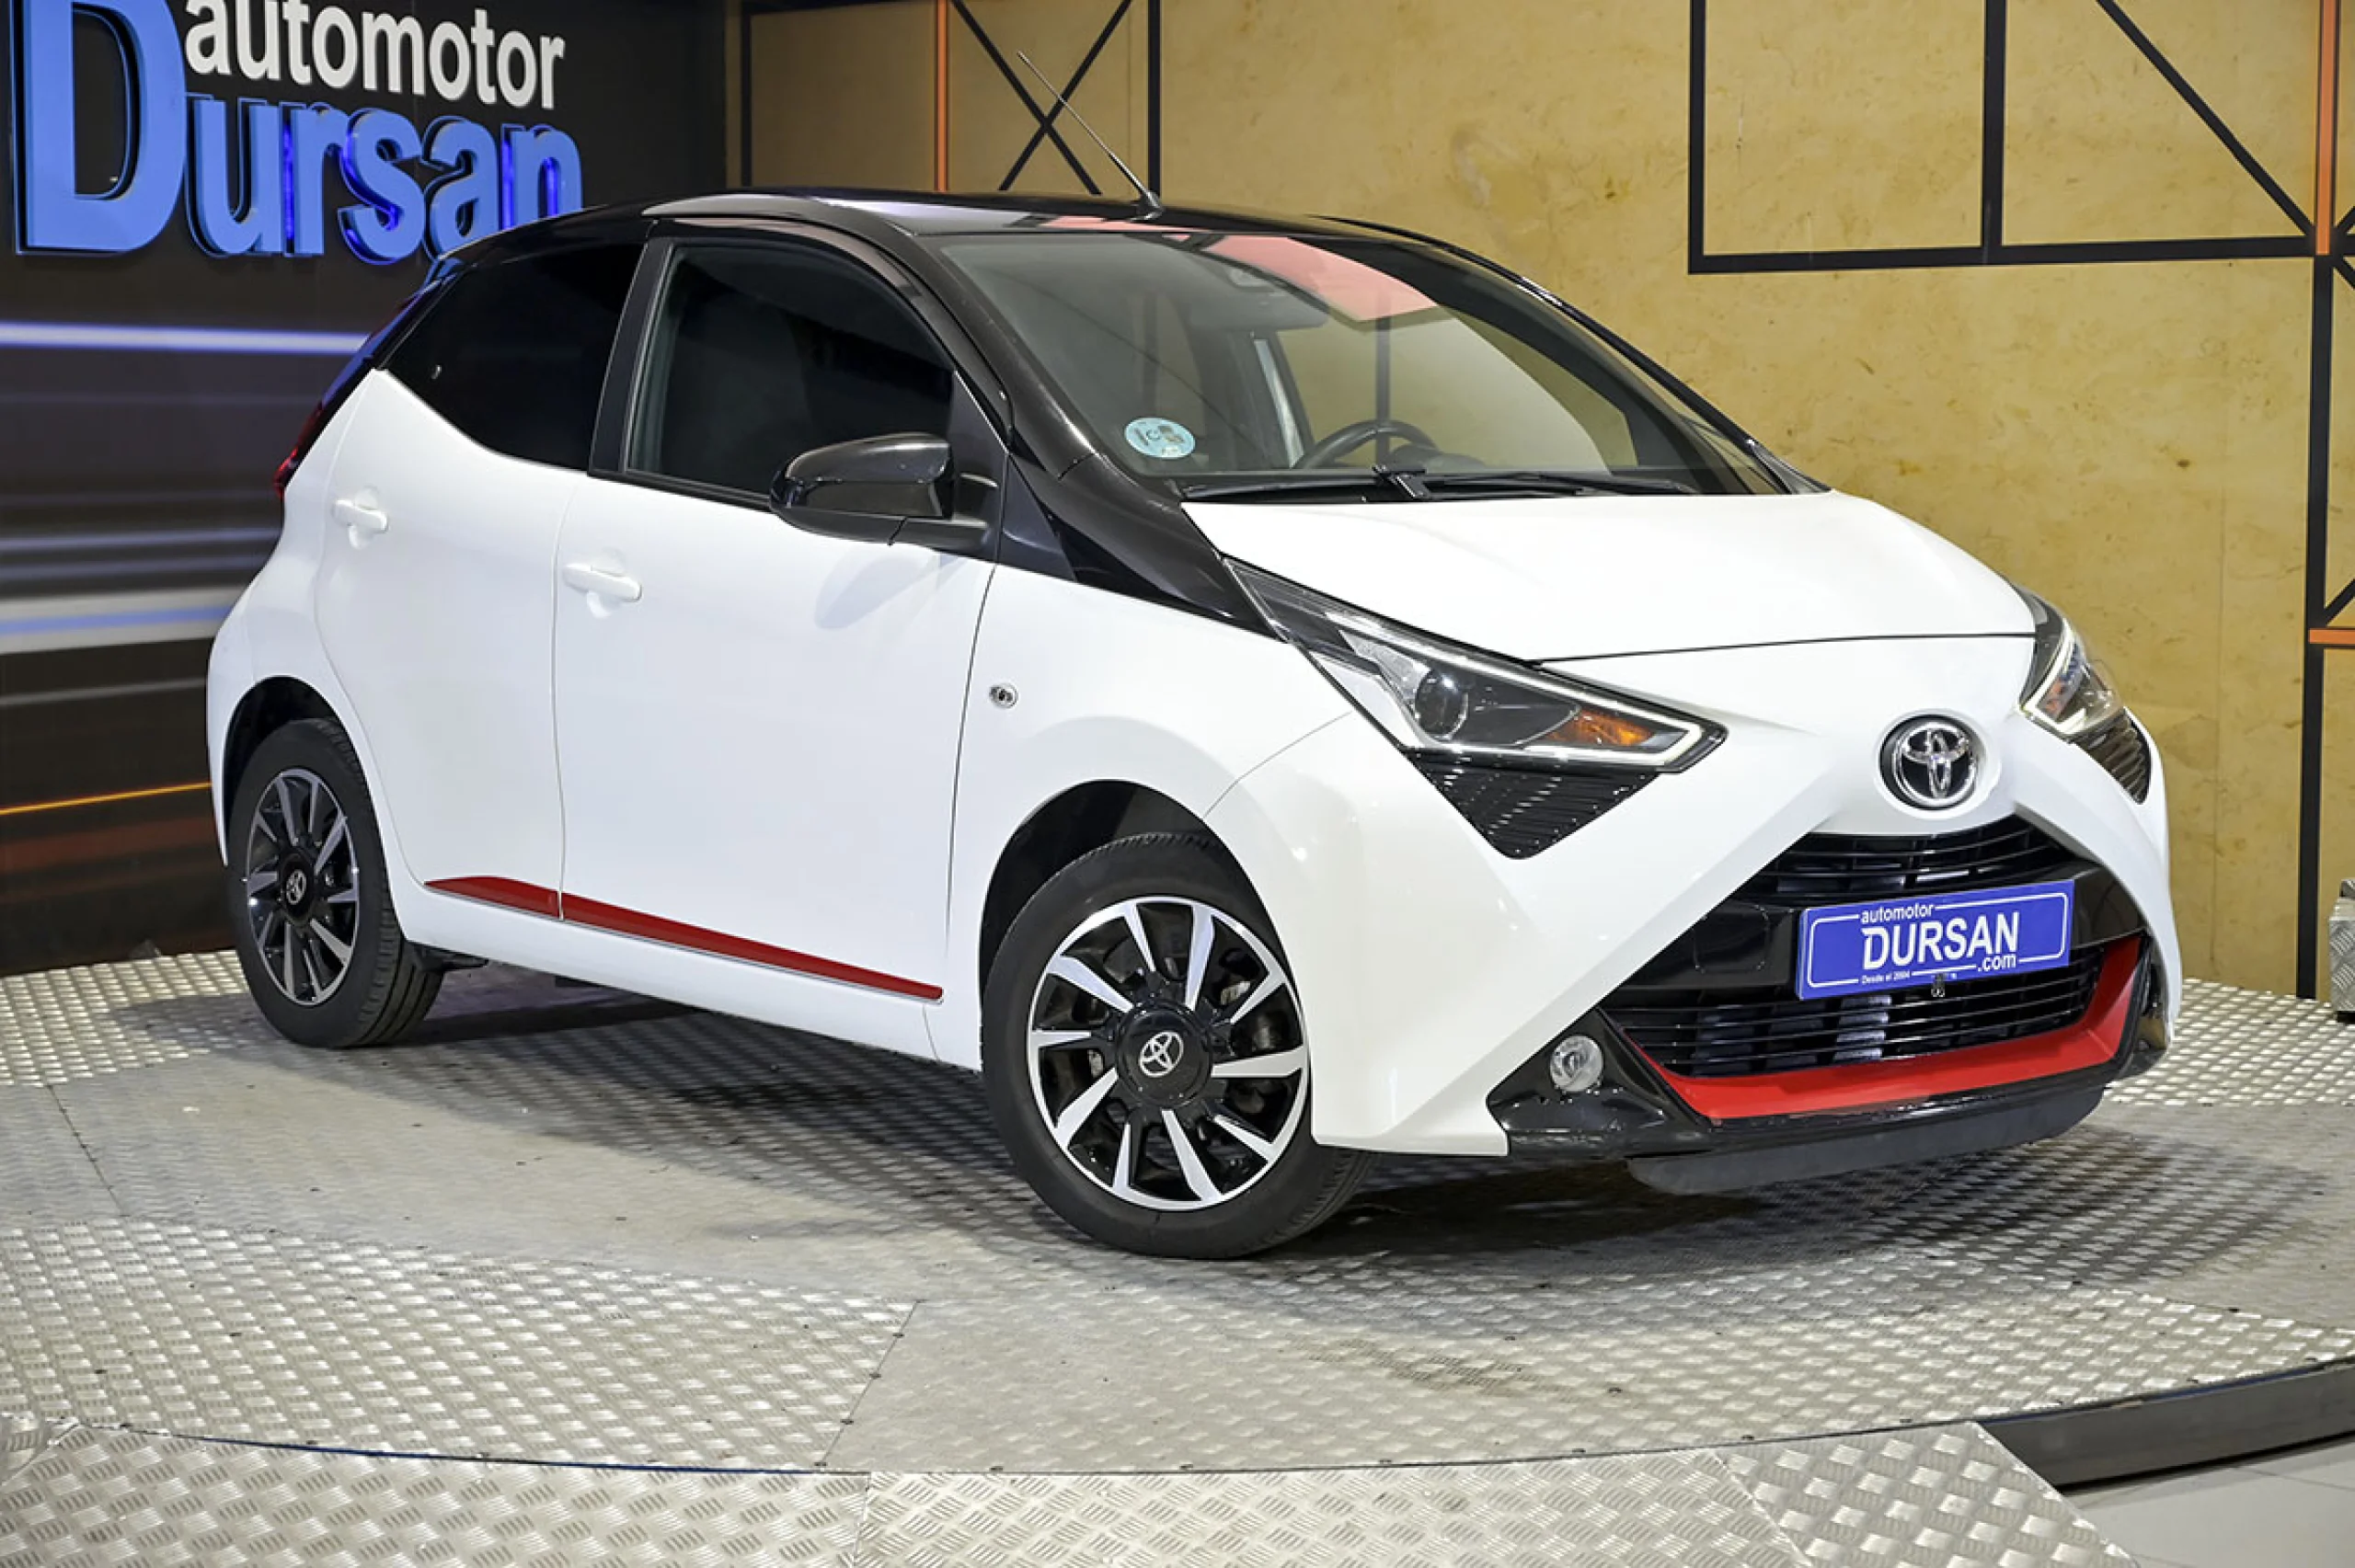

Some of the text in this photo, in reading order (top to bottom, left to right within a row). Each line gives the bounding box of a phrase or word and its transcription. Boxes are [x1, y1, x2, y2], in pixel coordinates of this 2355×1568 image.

[185, 0, 566, 109] automotor
[14, 0, 582, 262] Dursan
[1860, 911, 2020, 970] DURSAN
[1861, 902, 1934, 924] automotor
[1977, 953, 2017, 972] .com
